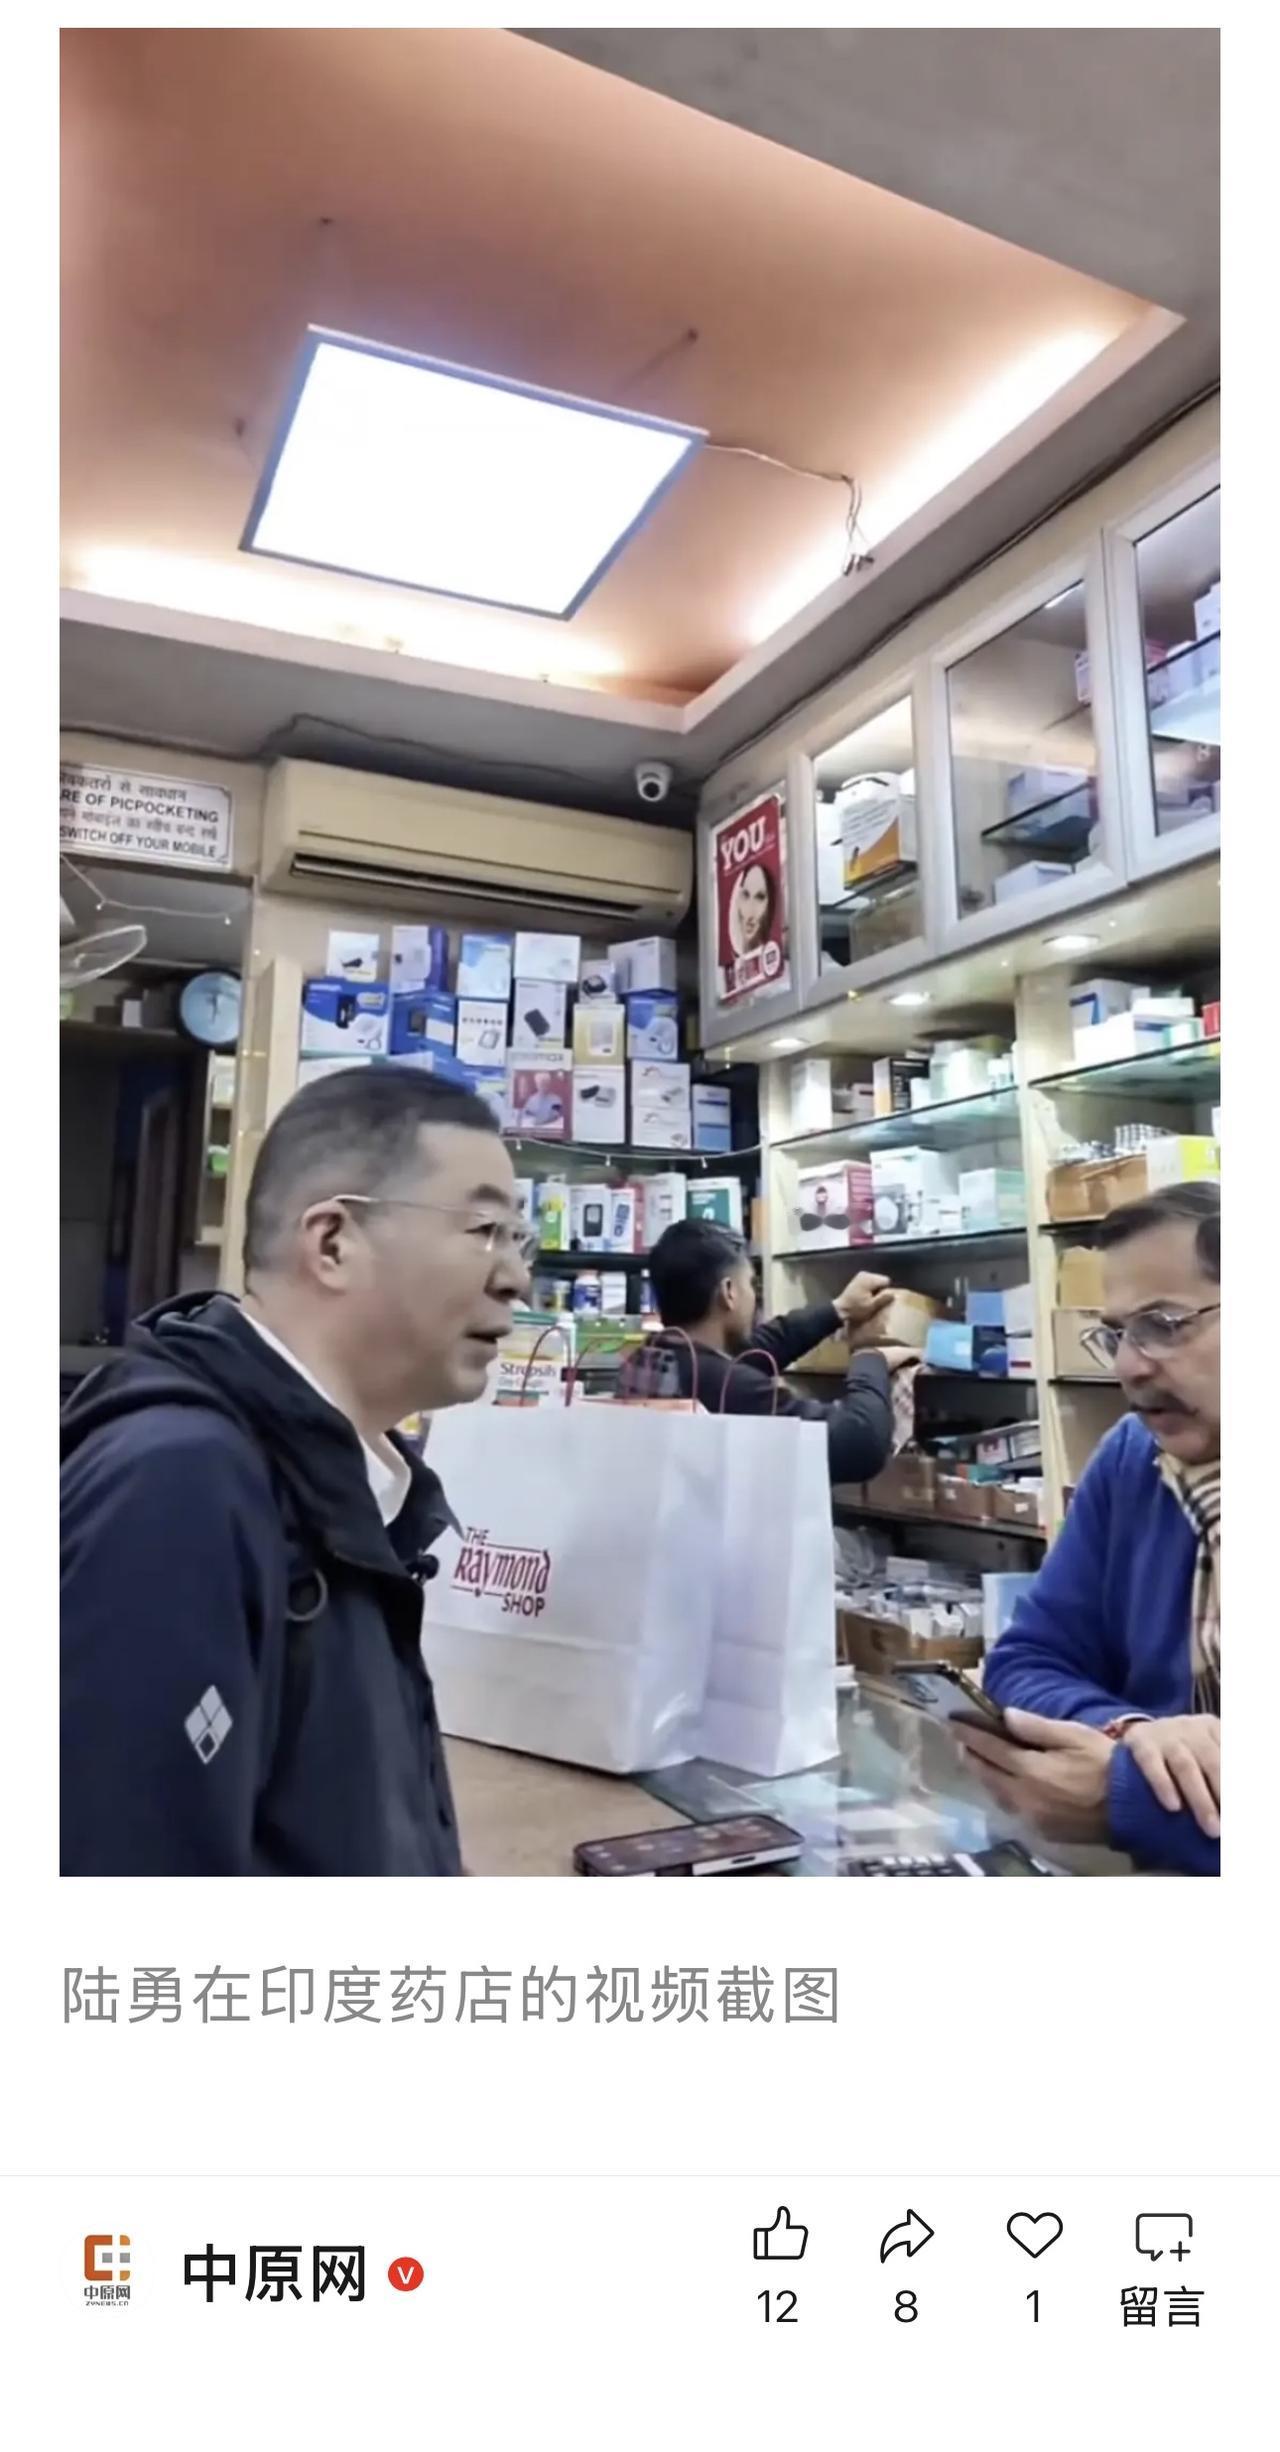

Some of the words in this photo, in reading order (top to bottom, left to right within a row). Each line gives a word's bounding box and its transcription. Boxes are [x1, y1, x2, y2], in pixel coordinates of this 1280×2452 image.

[85, 793, 106, 807] OF
[110, 795, 219, 824] PICPOCKETING
[60, 825, 106, 842] SWITCH
[110, 831, 134, 847] OFF
[136, 836, 170, 852] YOUR
[172, 840, 217, 859] MOBILE
[721, 815, 767, 871] YOU
[466, 1526, 490, 1546] THE
[454, 1547, 551, 1594] Raymond
[502, 1592, 546, 1618] SHOP
